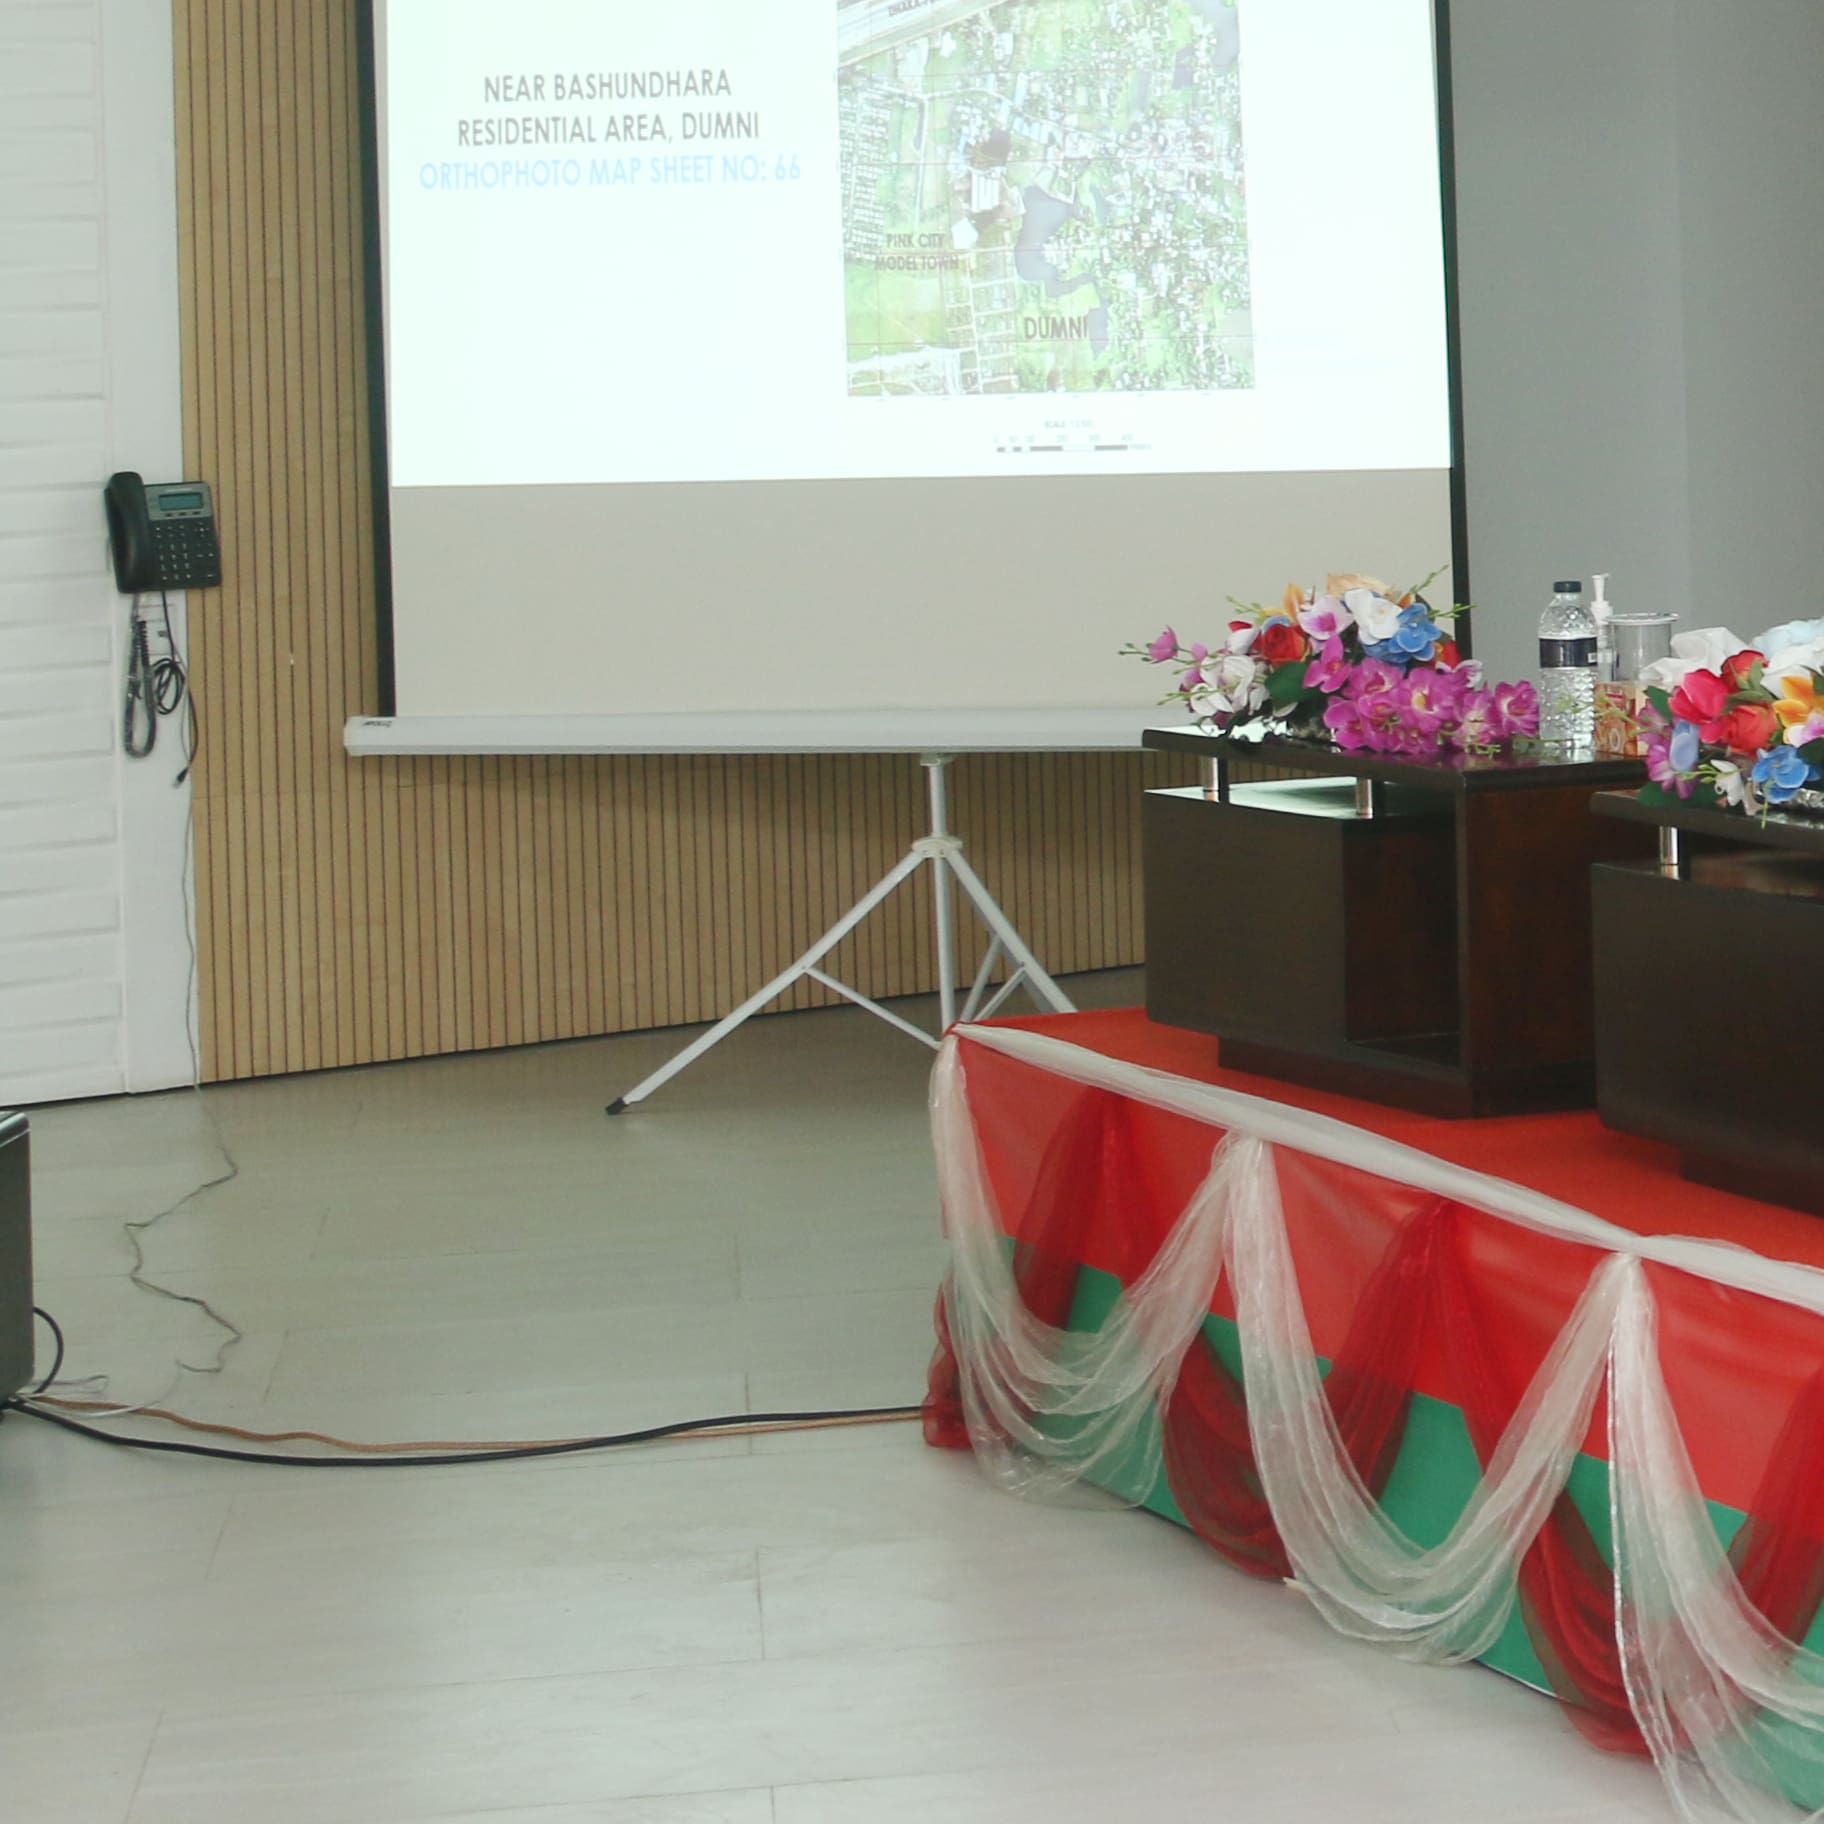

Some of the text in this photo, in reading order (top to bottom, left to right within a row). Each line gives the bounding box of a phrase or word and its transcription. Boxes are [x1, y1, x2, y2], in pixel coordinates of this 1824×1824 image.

[484, 69, 732, 104] NEAR BASHUNDHARA
[458, 111, 760, 146] RESIDENTIAL AREA, DUMNI
[419, 159, 581, 190] ORTHOPHOTO
[589, 158, 642, 185] MAP
[650, 155, 719, 184] SHEET
[722, 155, 768, 183] NO:
[887, 231, 945, 249] PINK CITY
[1024, 316, 1088, 340] DUMNI
